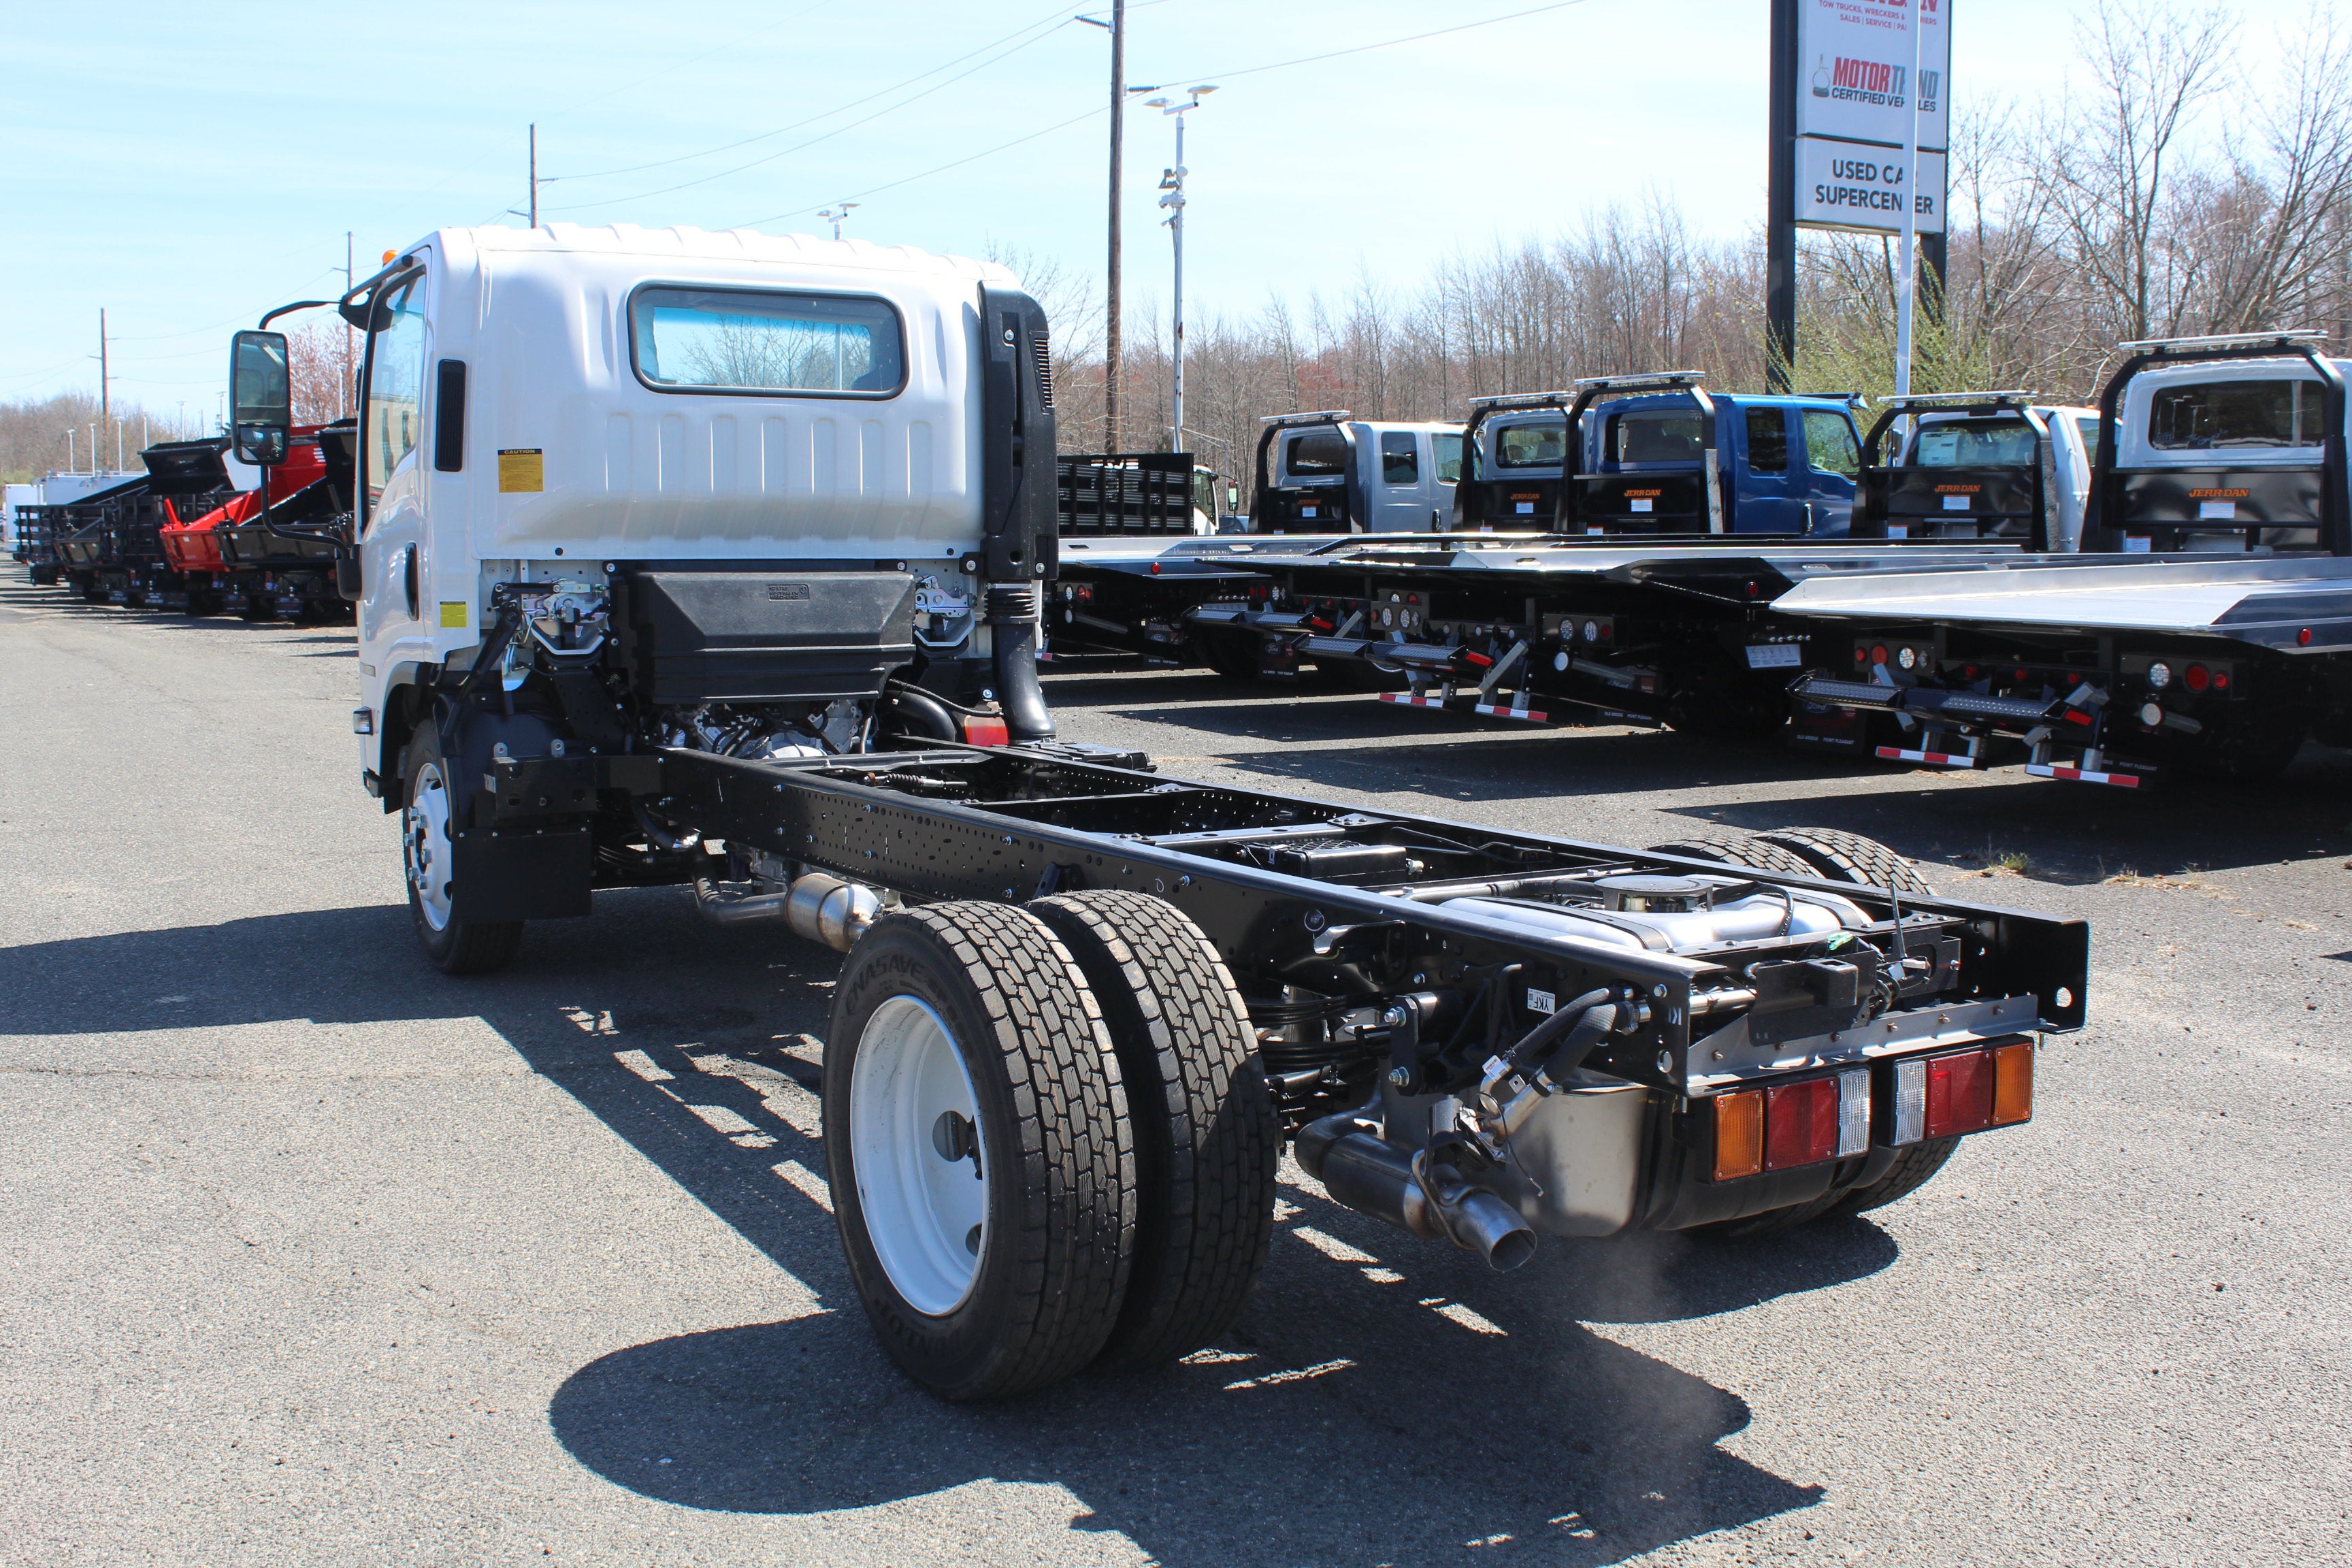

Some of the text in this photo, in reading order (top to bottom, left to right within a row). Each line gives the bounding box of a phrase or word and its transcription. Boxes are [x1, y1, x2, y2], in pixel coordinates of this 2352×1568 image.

[1818, 0, 1835, 9] TOW
[1864, 7, 1899, 19] WRECKERS
[1840, 14, 1861, 23] SALES
[1865, 18, 1892, 29] SERVICE
[1831, 87, 1885, 105] CERTIFIED
[1833, 159, 1878, 182] USED
[1815, 184, 1933, 215] SUPERCENER
[1533, 996, 1550, 1011] YKF
